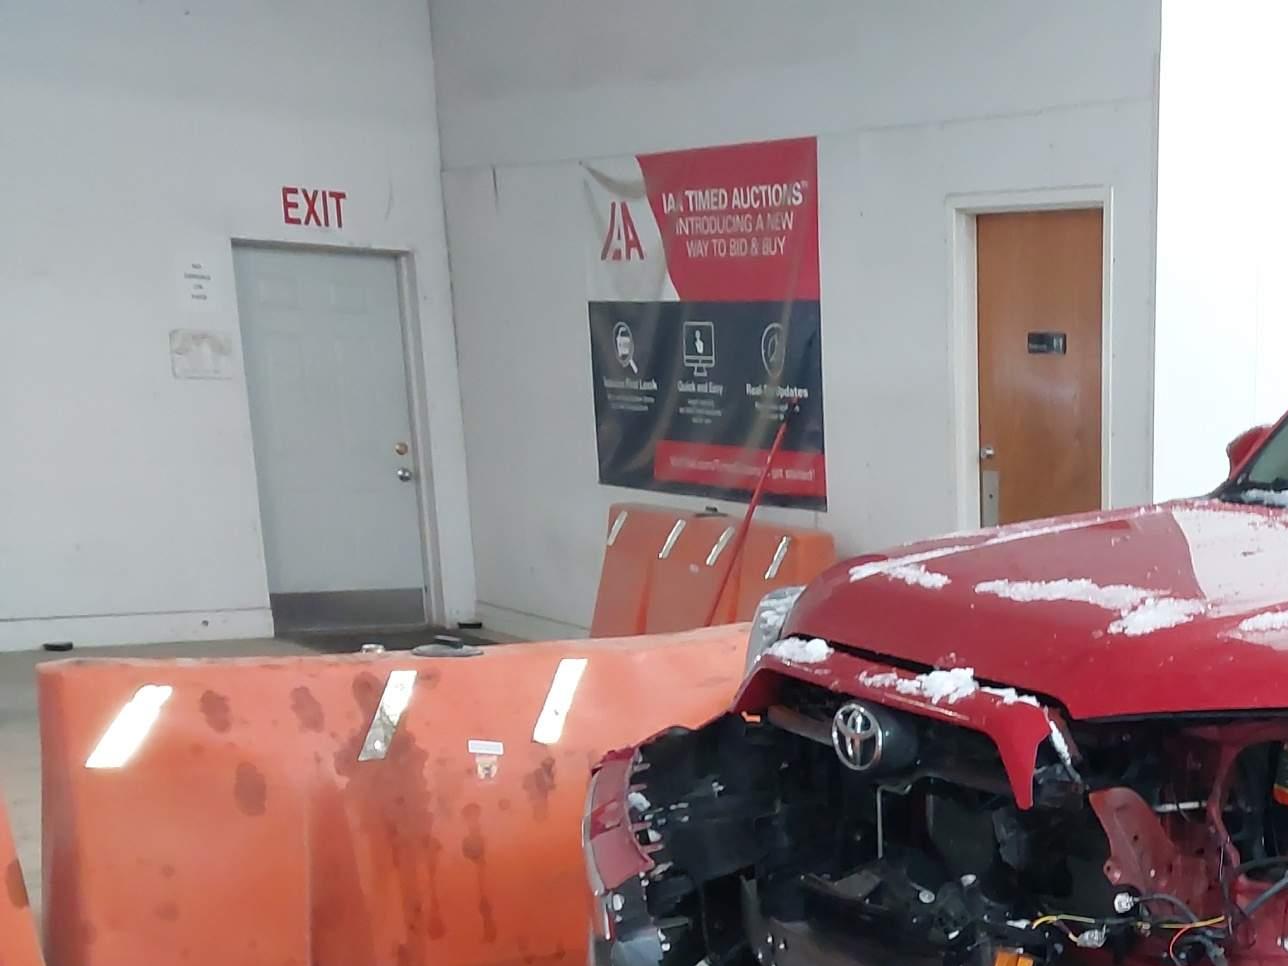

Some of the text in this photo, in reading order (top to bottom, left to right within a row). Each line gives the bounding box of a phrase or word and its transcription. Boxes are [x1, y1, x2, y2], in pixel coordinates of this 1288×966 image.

[282, 187, 346, 228] EXIT
[685, 188, 728, 212] TIMED
[675, 210, 794, 236] INTRODUCING A NEW
[686, 235, 787, 258] WAY TO BID & BUY
